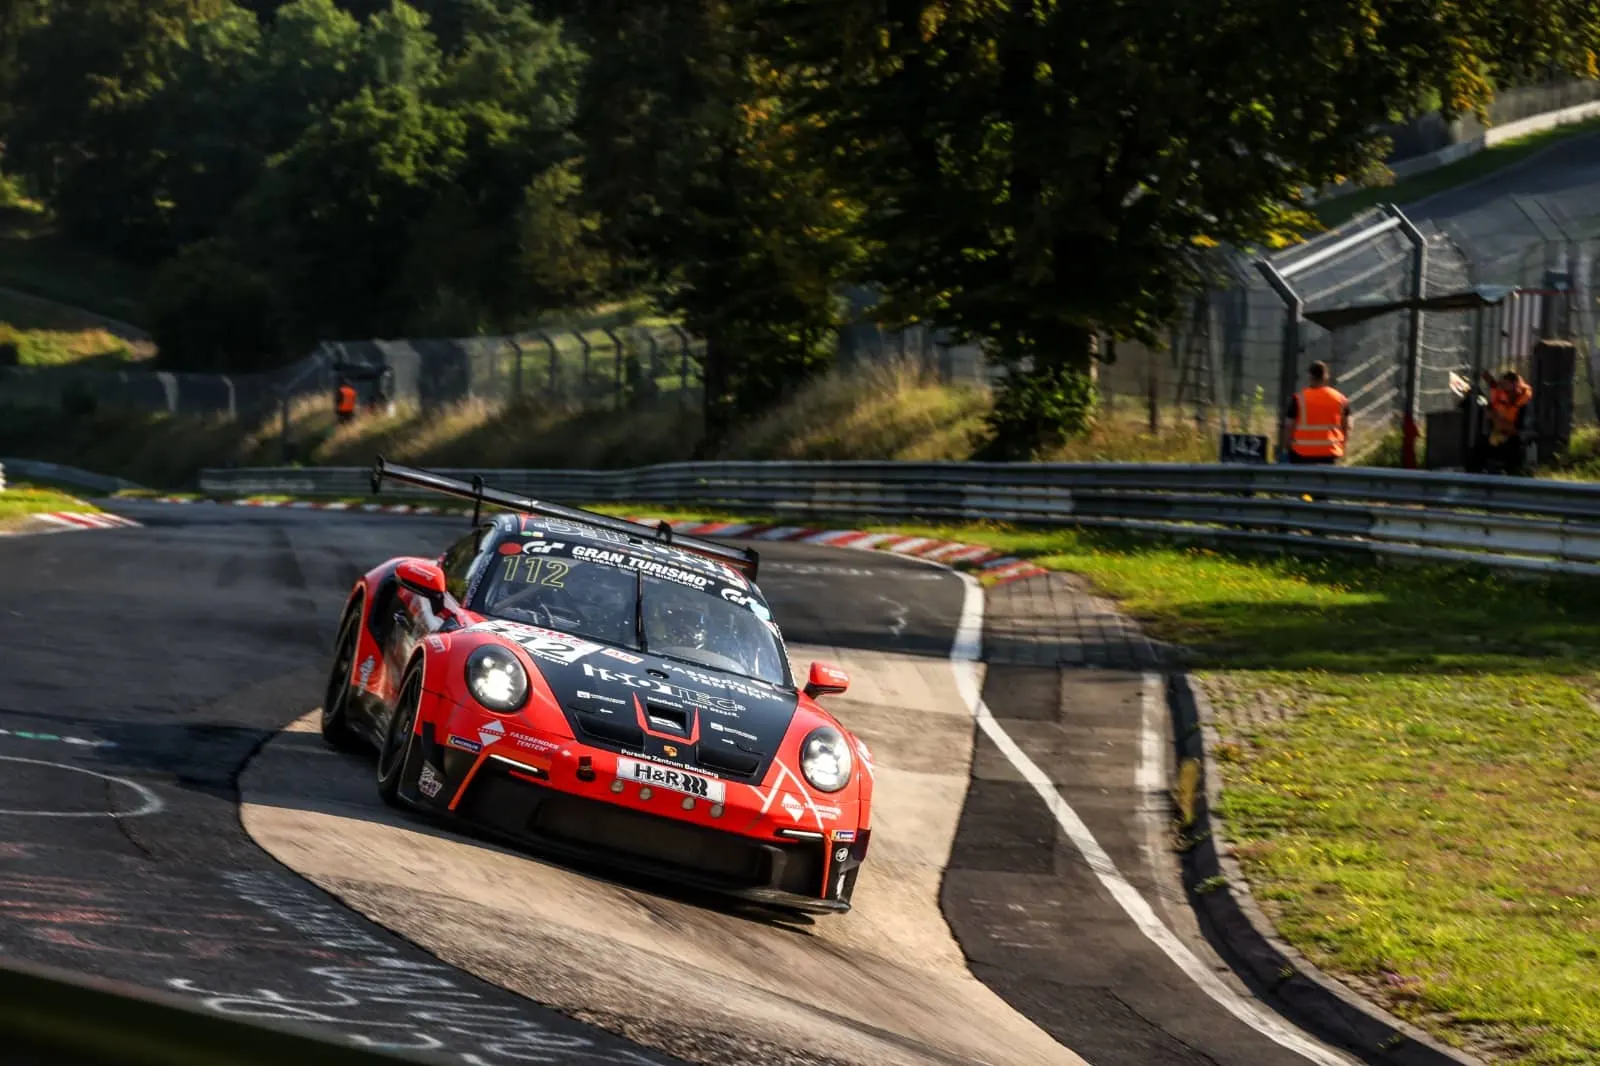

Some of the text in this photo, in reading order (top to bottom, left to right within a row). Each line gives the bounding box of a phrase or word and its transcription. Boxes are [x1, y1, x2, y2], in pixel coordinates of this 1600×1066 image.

[503, 555, 569, 588] 112
[571, 546, 625, 564] GRAN
[628, 556, 707, 586] TURISMO
[620, 748, 652, 760] Porsche
[652, 755, 684, 769] Zentrum
[634, 763, 680, 786] H&R
